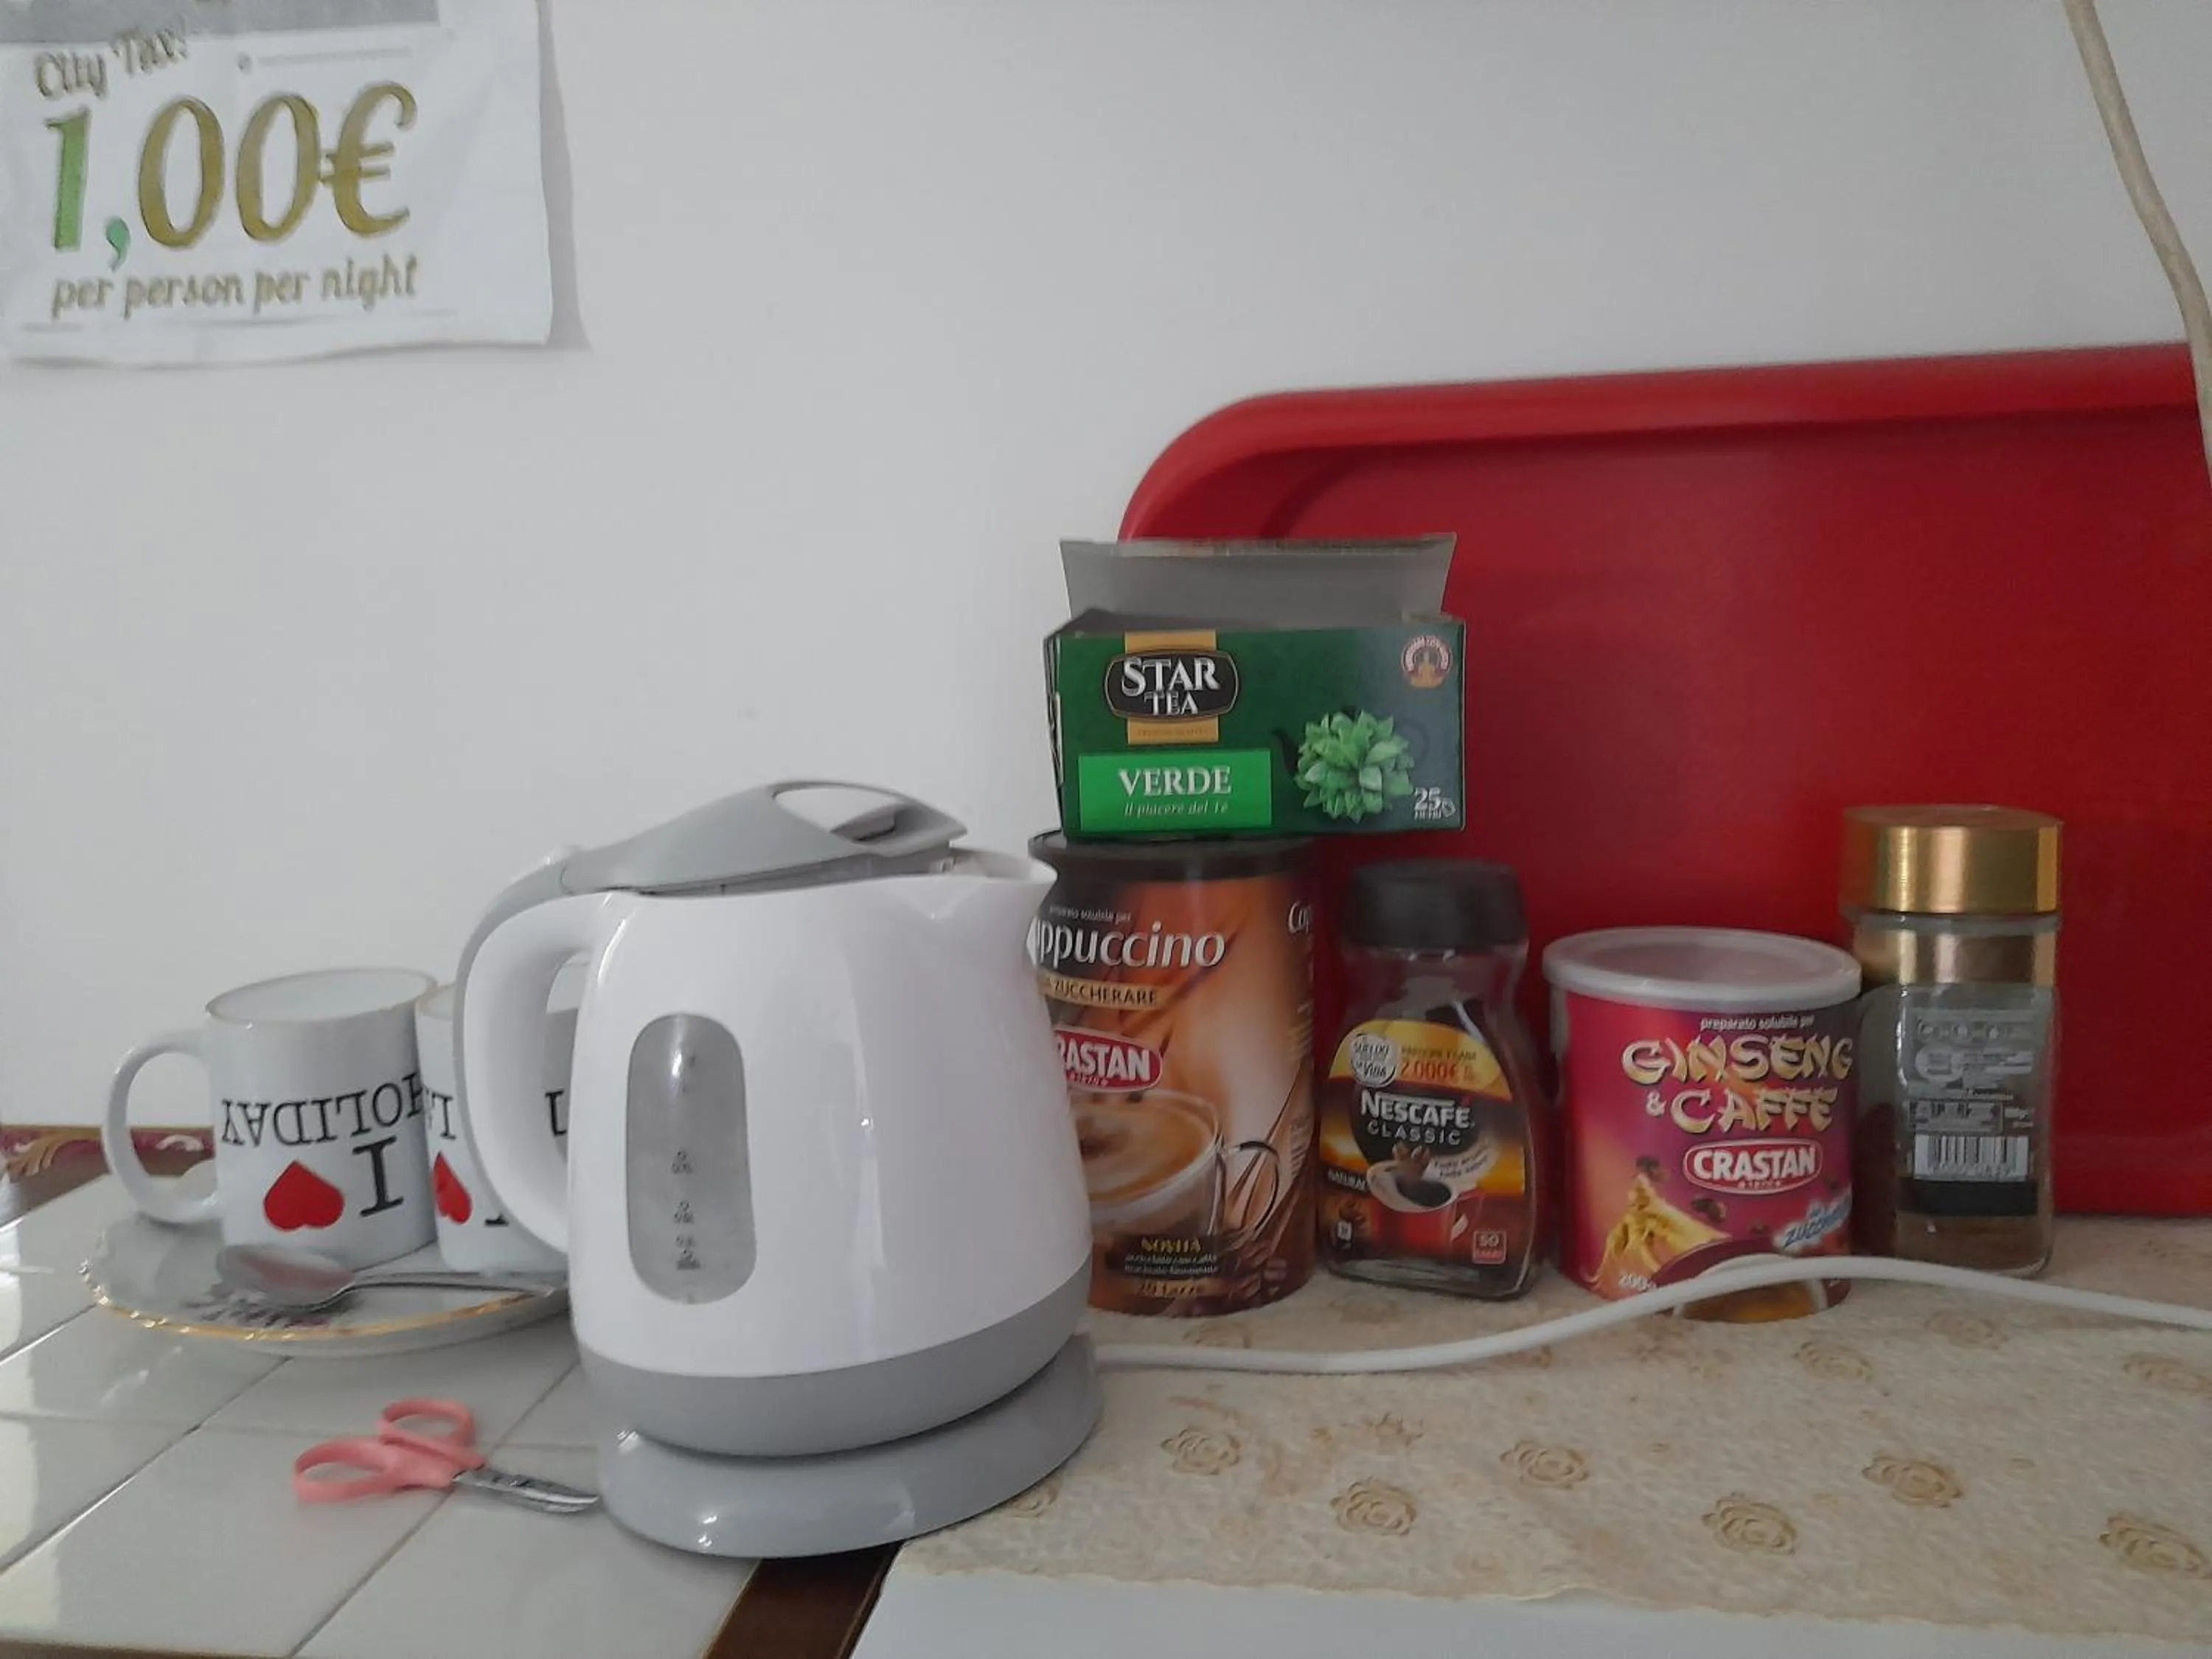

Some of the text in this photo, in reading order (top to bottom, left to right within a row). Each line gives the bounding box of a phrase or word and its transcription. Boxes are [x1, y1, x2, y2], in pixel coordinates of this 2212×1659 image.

[34, 52, 109, 100] City
[45, 80, 418, 272] 1,00€
[52, 254, 418, 319] per person per night
[1121, 657, 1221, 697] STAR
[1144, 690, 1200, 715] TEA
[1118, 765, 1232, 797] VERDE
[1413, 786, 1441, 810] 25
[1037, 920, 1225, 969] ppuccino
[1621, 1033, 1854, 1085] GINSENG
[1646, 1091, 1666, 1117] &
[1367, 1119, 1461, 1146] CLASSIC
[352, 1136, 404, 1217] I
[1694, 1146, 1816, 1181] CRASTAN
